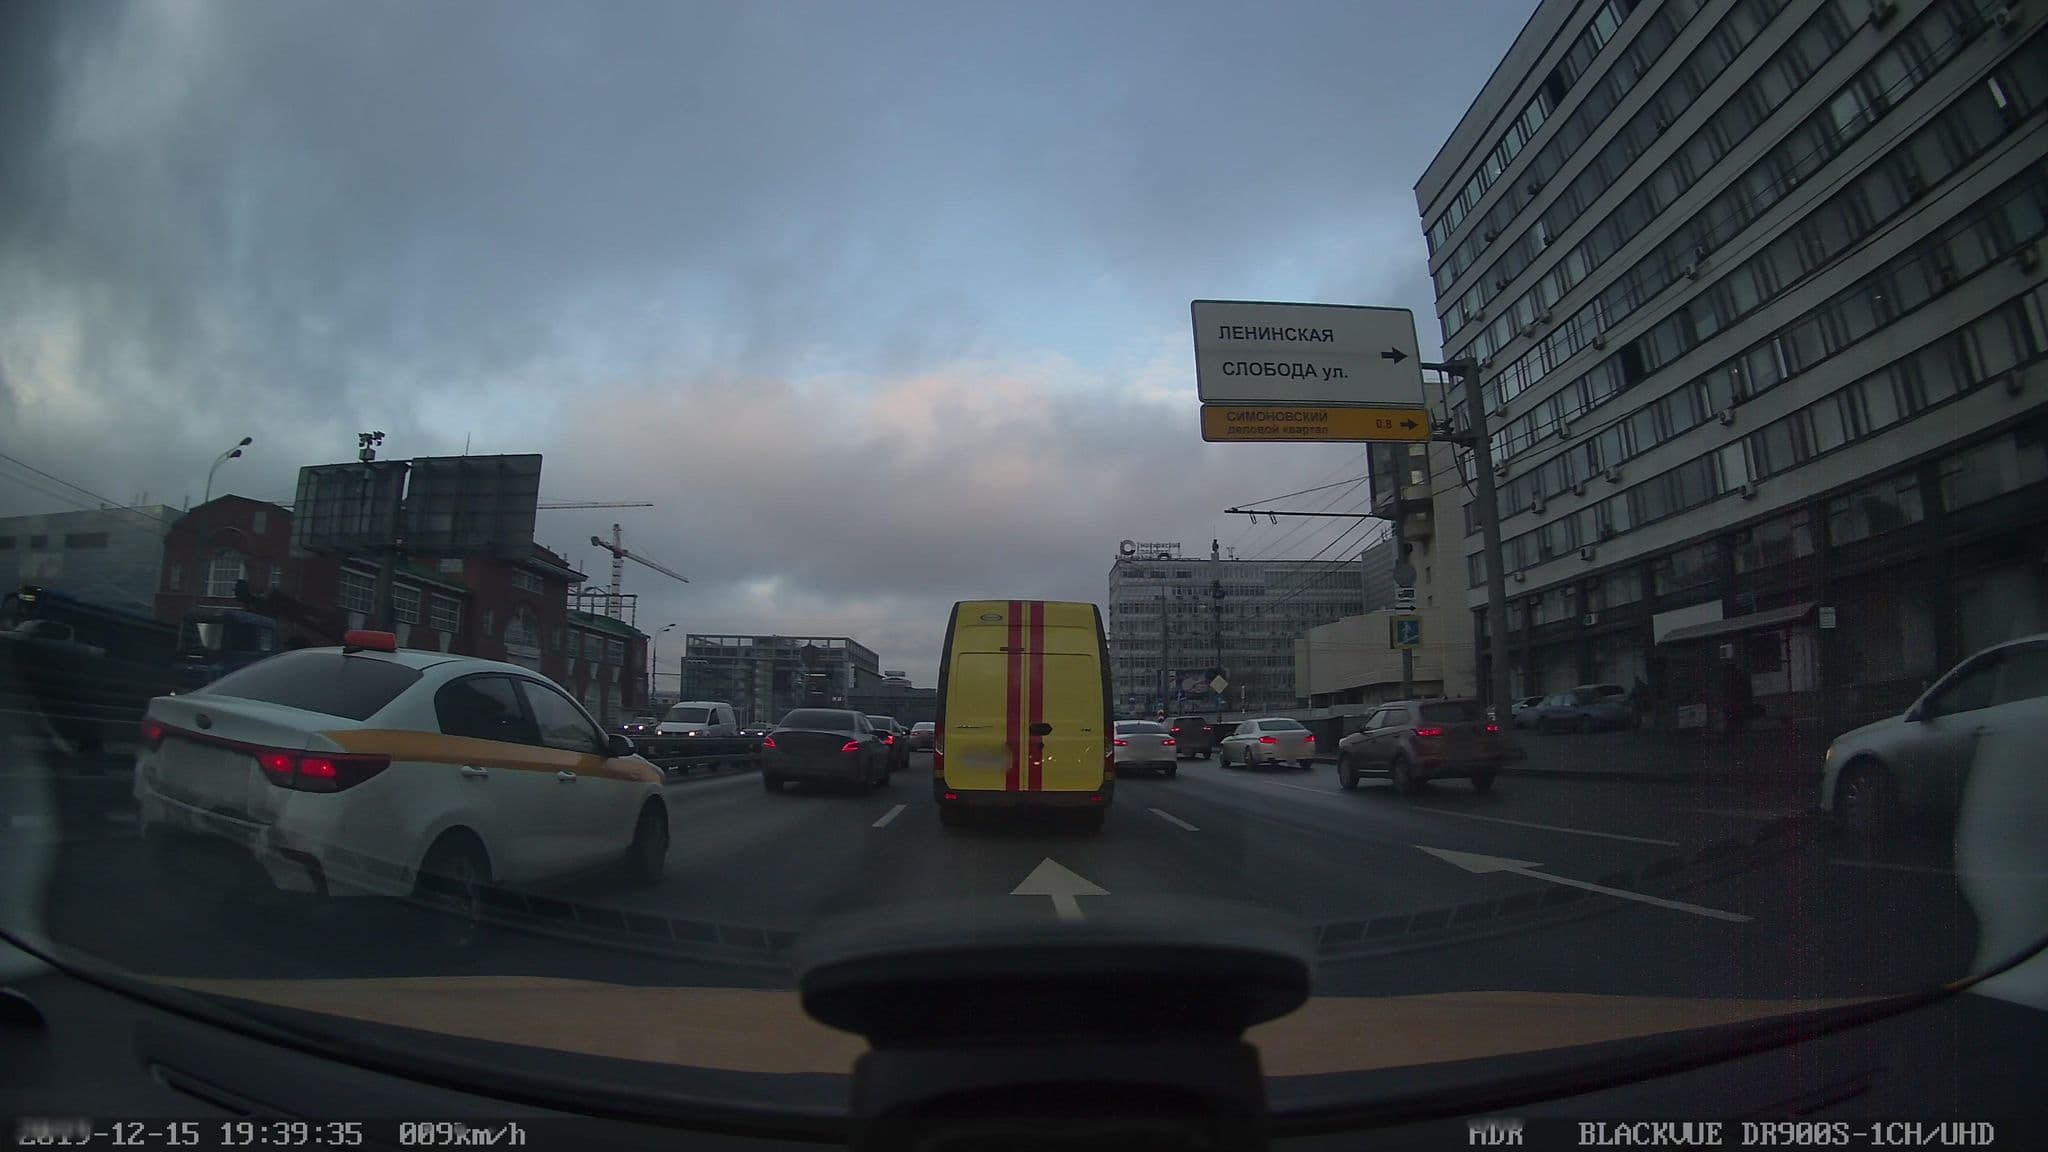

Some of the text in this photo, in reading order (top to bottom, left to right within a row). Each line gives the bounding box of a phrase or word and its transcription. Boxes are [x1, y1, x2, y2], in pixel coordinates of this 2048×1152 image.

[1218, 326, 1334, 343] ЛЕНИНСКАЯ
[1222, 362, 1349, 381] СЛОБОДА ул.
